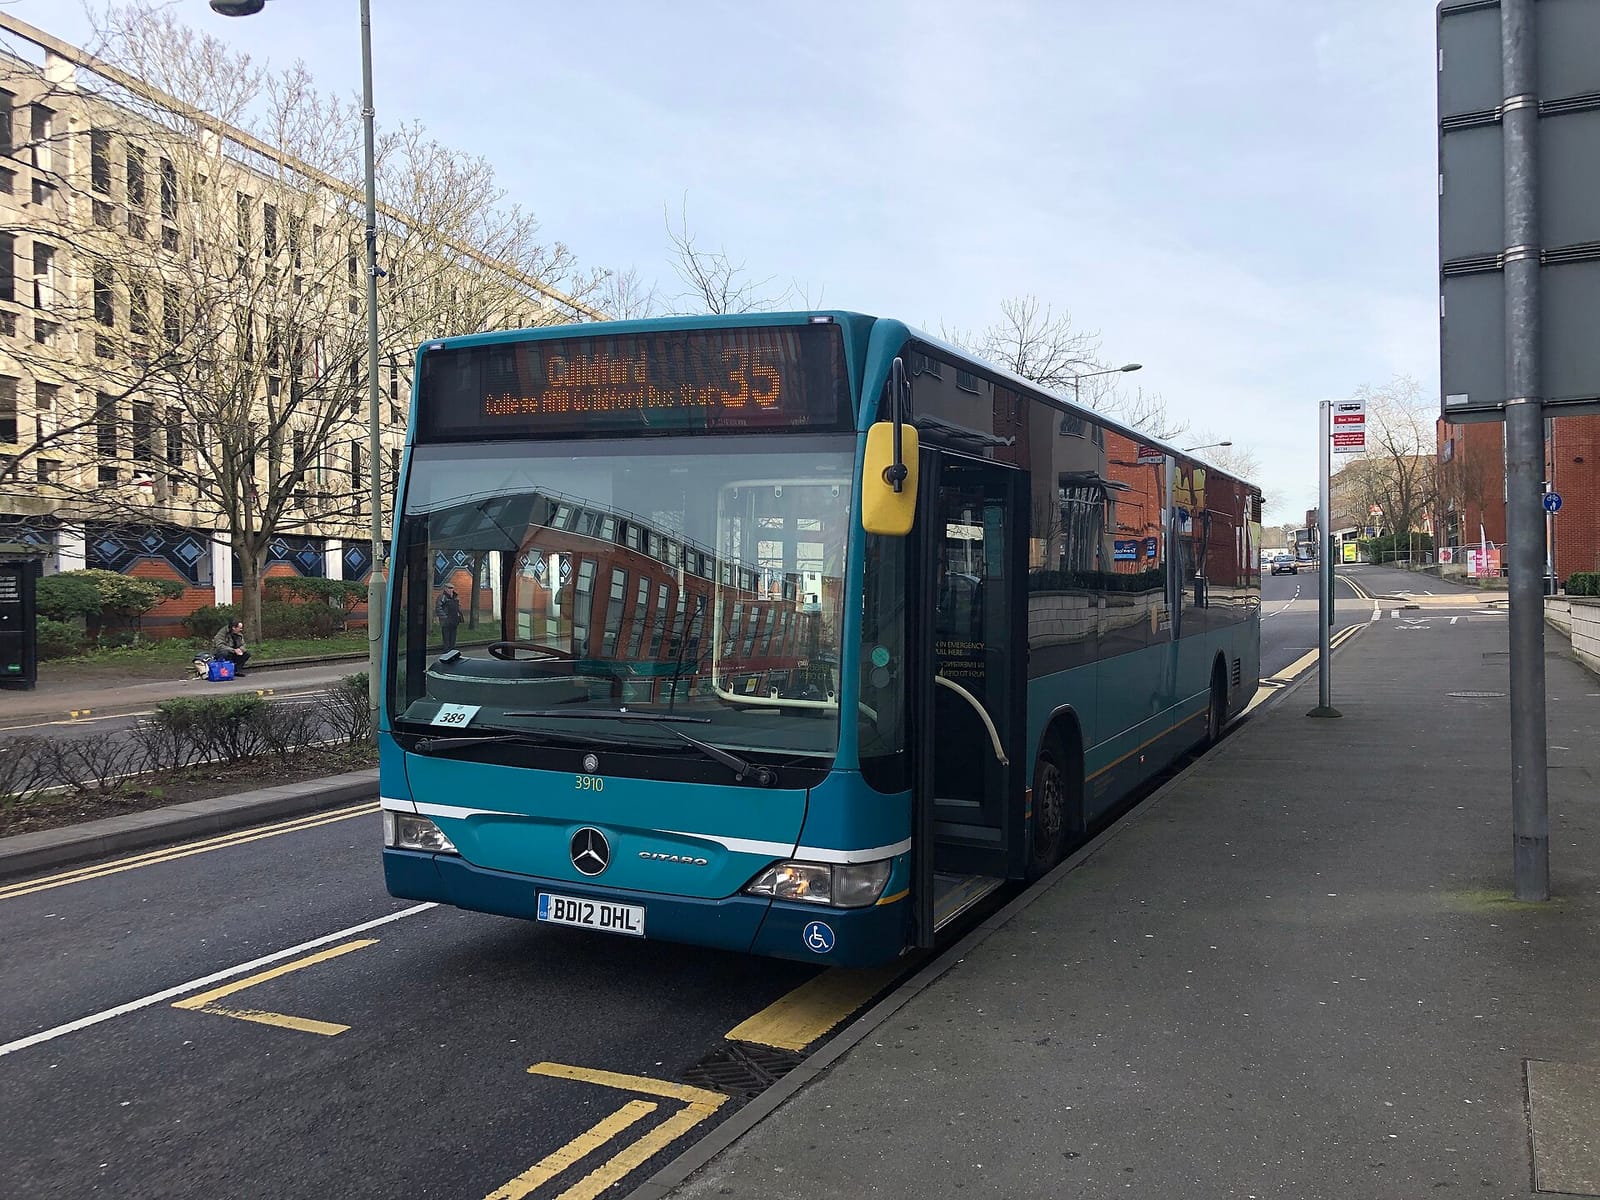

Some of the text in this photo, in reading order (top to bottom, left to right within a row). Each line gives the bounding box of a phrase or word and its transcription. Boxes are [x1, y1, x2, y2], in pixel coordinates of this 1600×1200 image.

[548, 351, 646, 387] Guildford
[721, 346, 782, 408] 35
[486, 393, 538, 415] College
[542, 390, 569, 413] AND
[573, 386, 644, 411] Guildford
[648, 385, 675, 408] Bus
[439, 712, 466, 724] 389
[575, 775, 604, 792] 3910
[638, 851, 708, 866] CITARO
[553, 898, 637, 931] BD12 DHL
